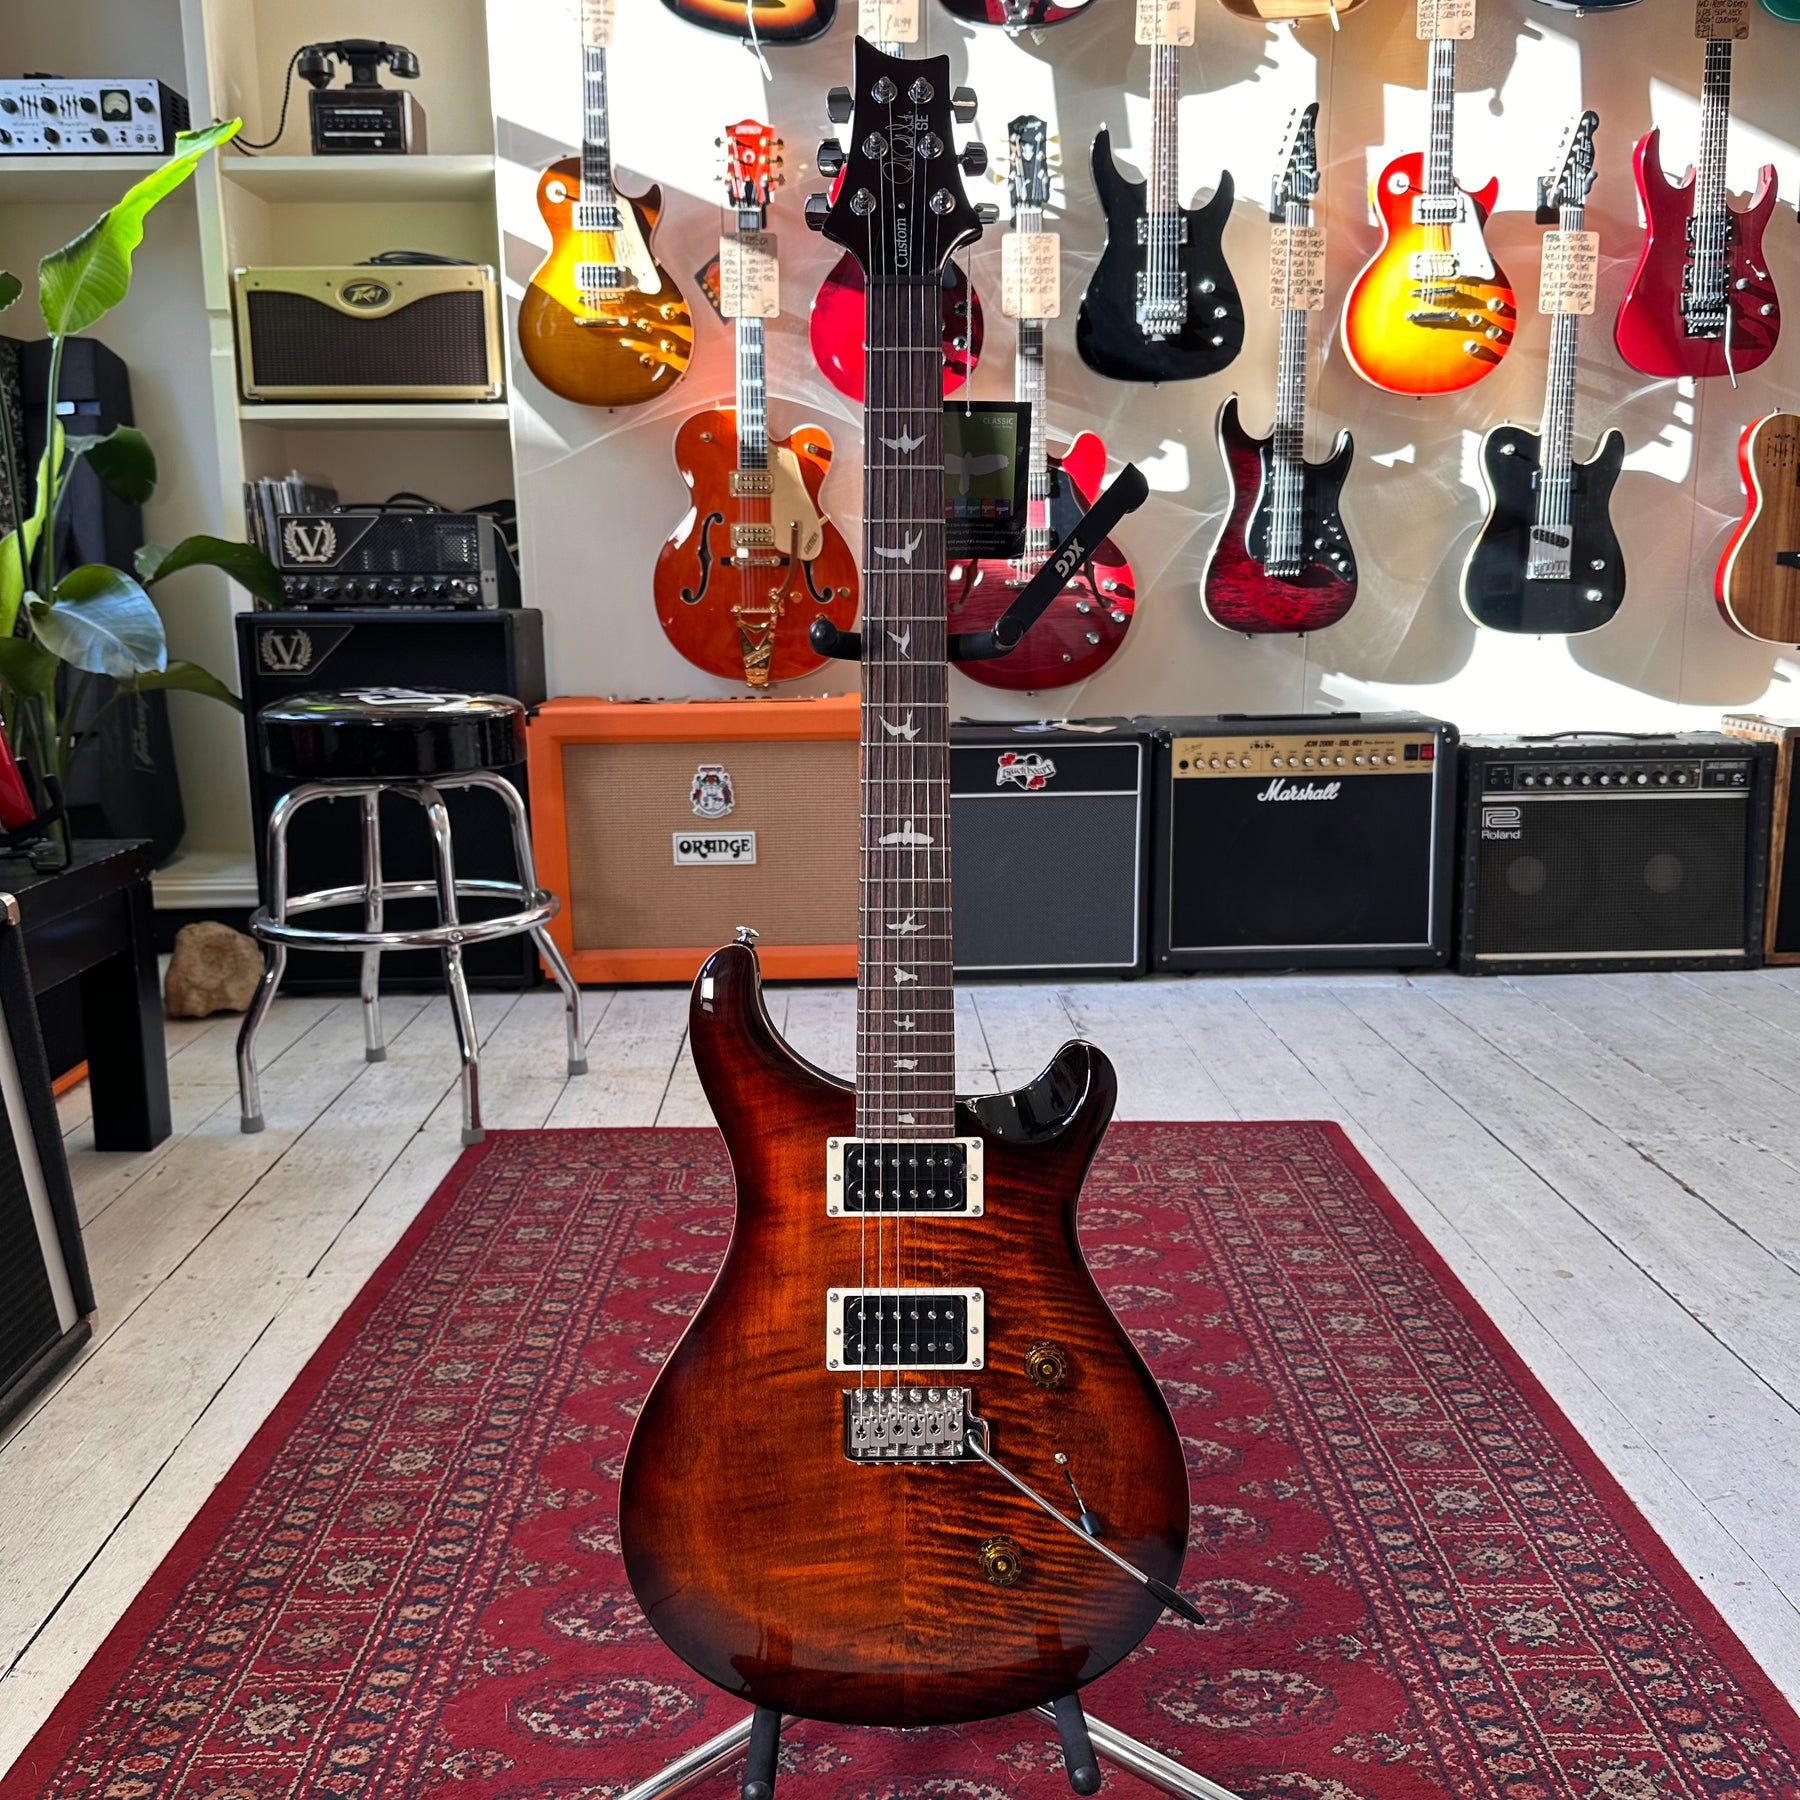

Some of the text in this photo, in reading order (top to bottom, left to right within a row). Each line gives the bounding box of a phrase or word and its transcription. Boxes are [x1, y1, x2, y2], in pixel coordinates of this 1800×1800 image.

[917, 114, 929, 131] SE
[894, 217, 909, 268] Custom
[982, 417, 1014, 425] CLASSIC
[1054, 537, 1086, 579] XCG
[1256, 778, 1341, 801] Marshall
[1481, 829, 1521, 840] Roland
[679, 838, 751, 859] ORANGE
